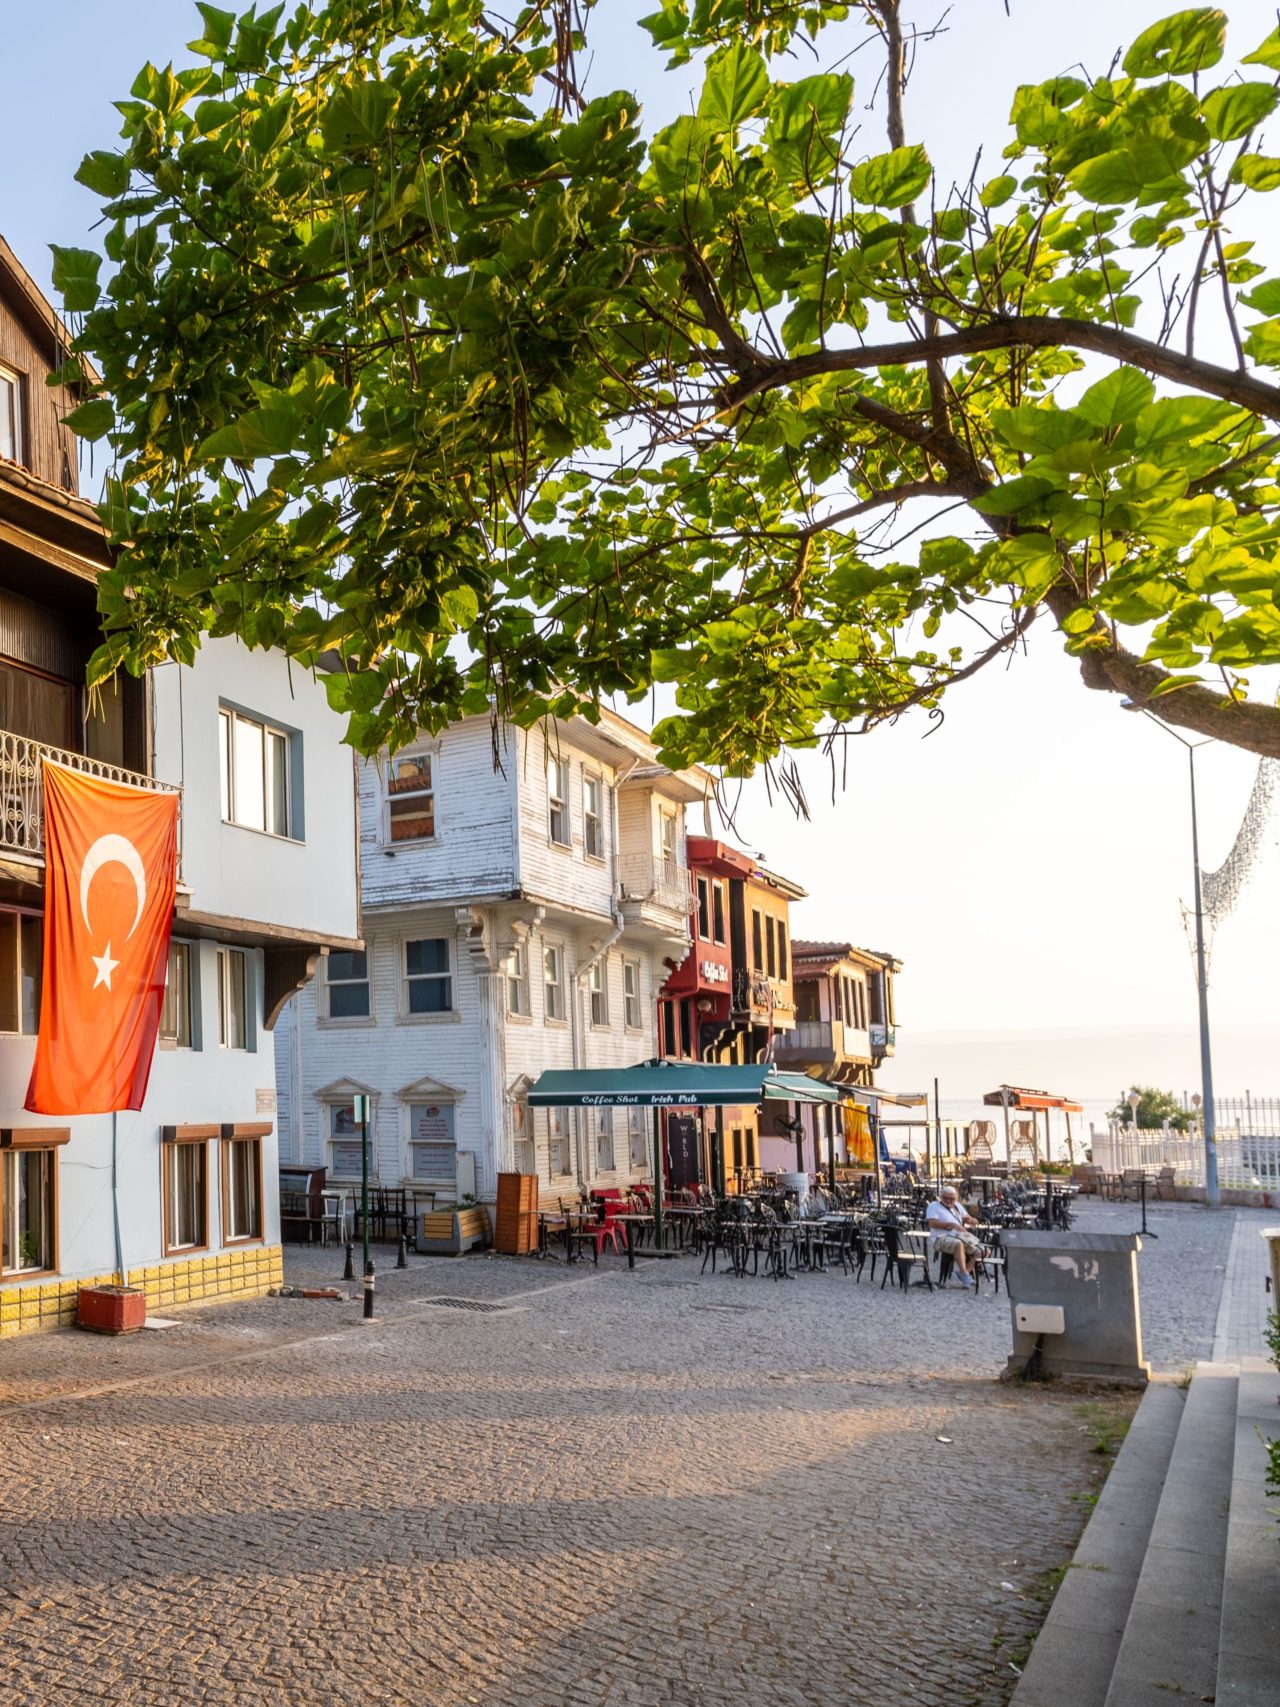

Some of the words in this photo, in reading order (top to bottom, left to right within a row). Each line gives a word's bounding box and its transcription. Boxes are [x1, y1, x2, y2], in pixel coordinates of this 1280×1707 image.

[581, 1095, 614, 1105] Coffee
[615, 1095, 639, 1104] Shot
[650, 1095, 674, 1104] Irish
[678, 1094, 698, 1104] Pub
